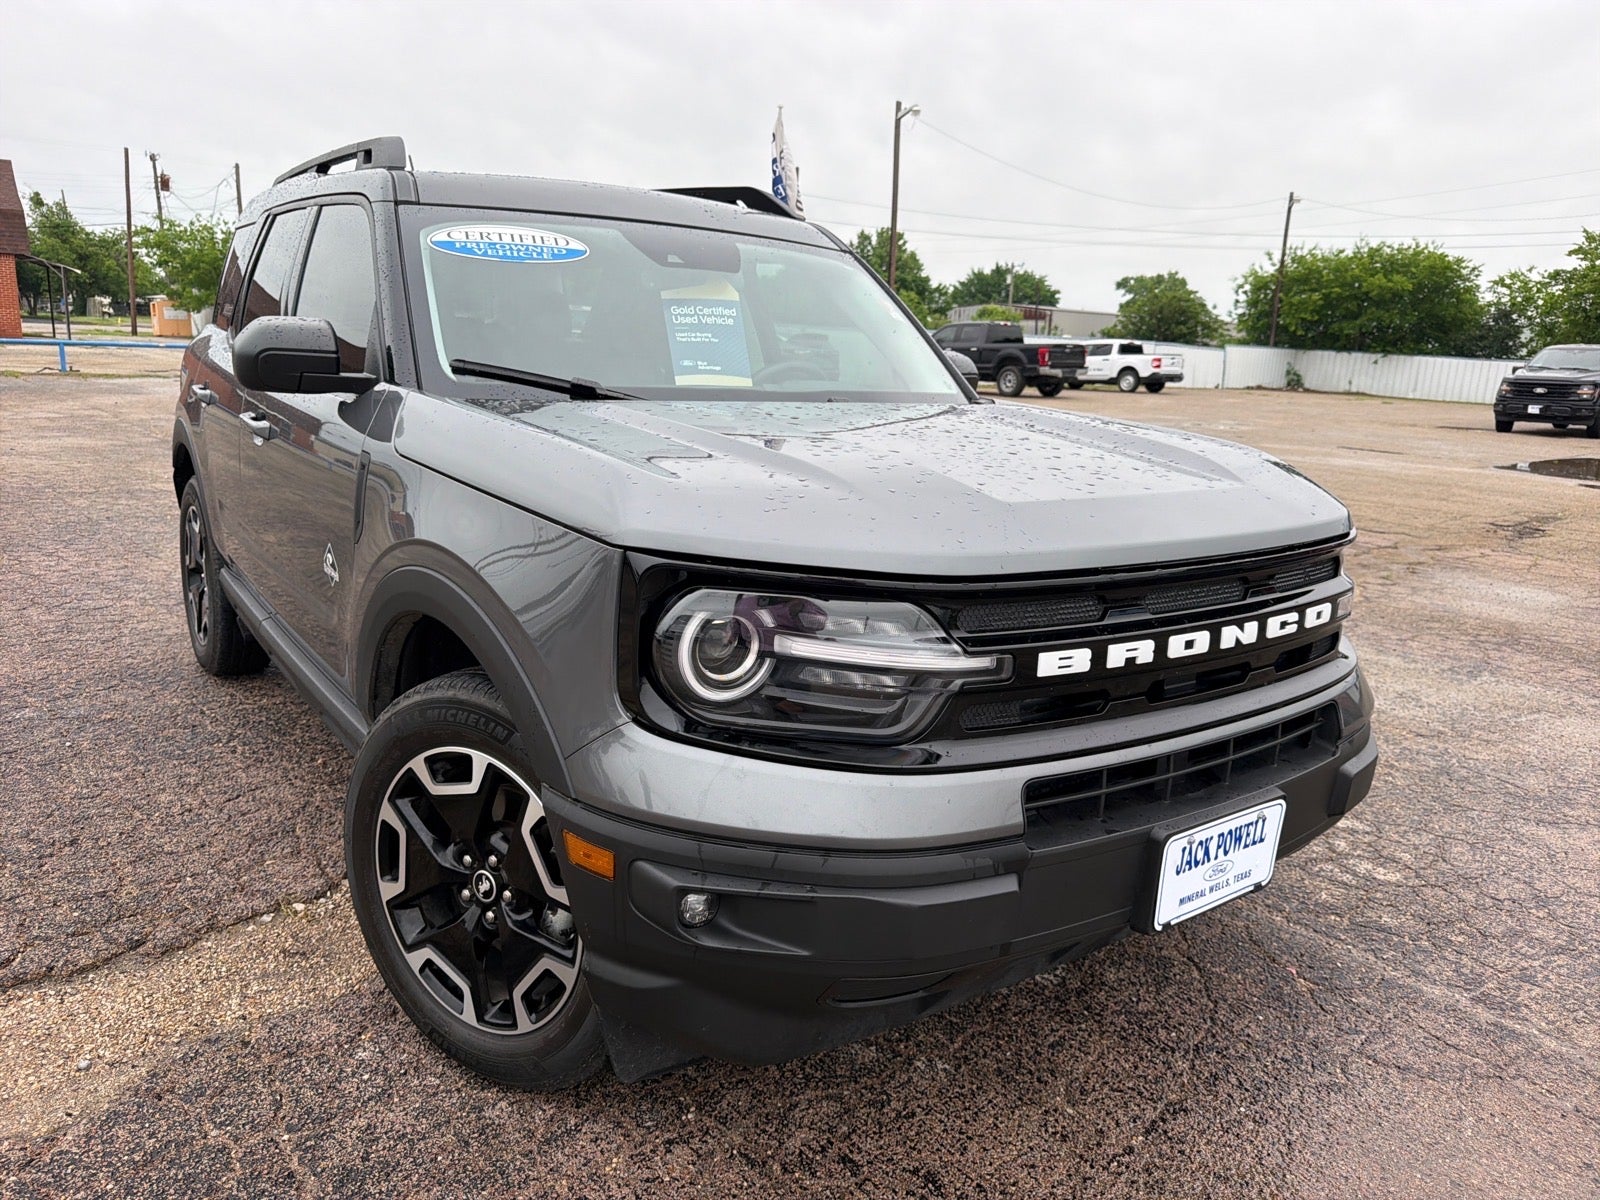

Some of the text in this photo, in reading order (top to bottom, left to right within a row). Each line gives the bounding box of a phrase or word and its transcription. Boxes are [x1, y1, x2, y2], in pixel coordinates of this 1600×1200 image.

[446, 230, 570, 247] CERTIFIED
[454, 241, 567, 255] PRE-OWNED
[471, 248, 553, 260] VEHICLE
[670, 305, 737, 317] Gold Certified
[672, 315, 734, 325] Used Vehicle
[1036, 602, 1333, 678] BRONCO
[426, 708, 508, 742] MICHELIN
[1175, 817, 1267, 877] JACK POWELL
[1178, 887, 1207, 907] MINERAL
[1233, 869, 1252, 885] TEXAS
